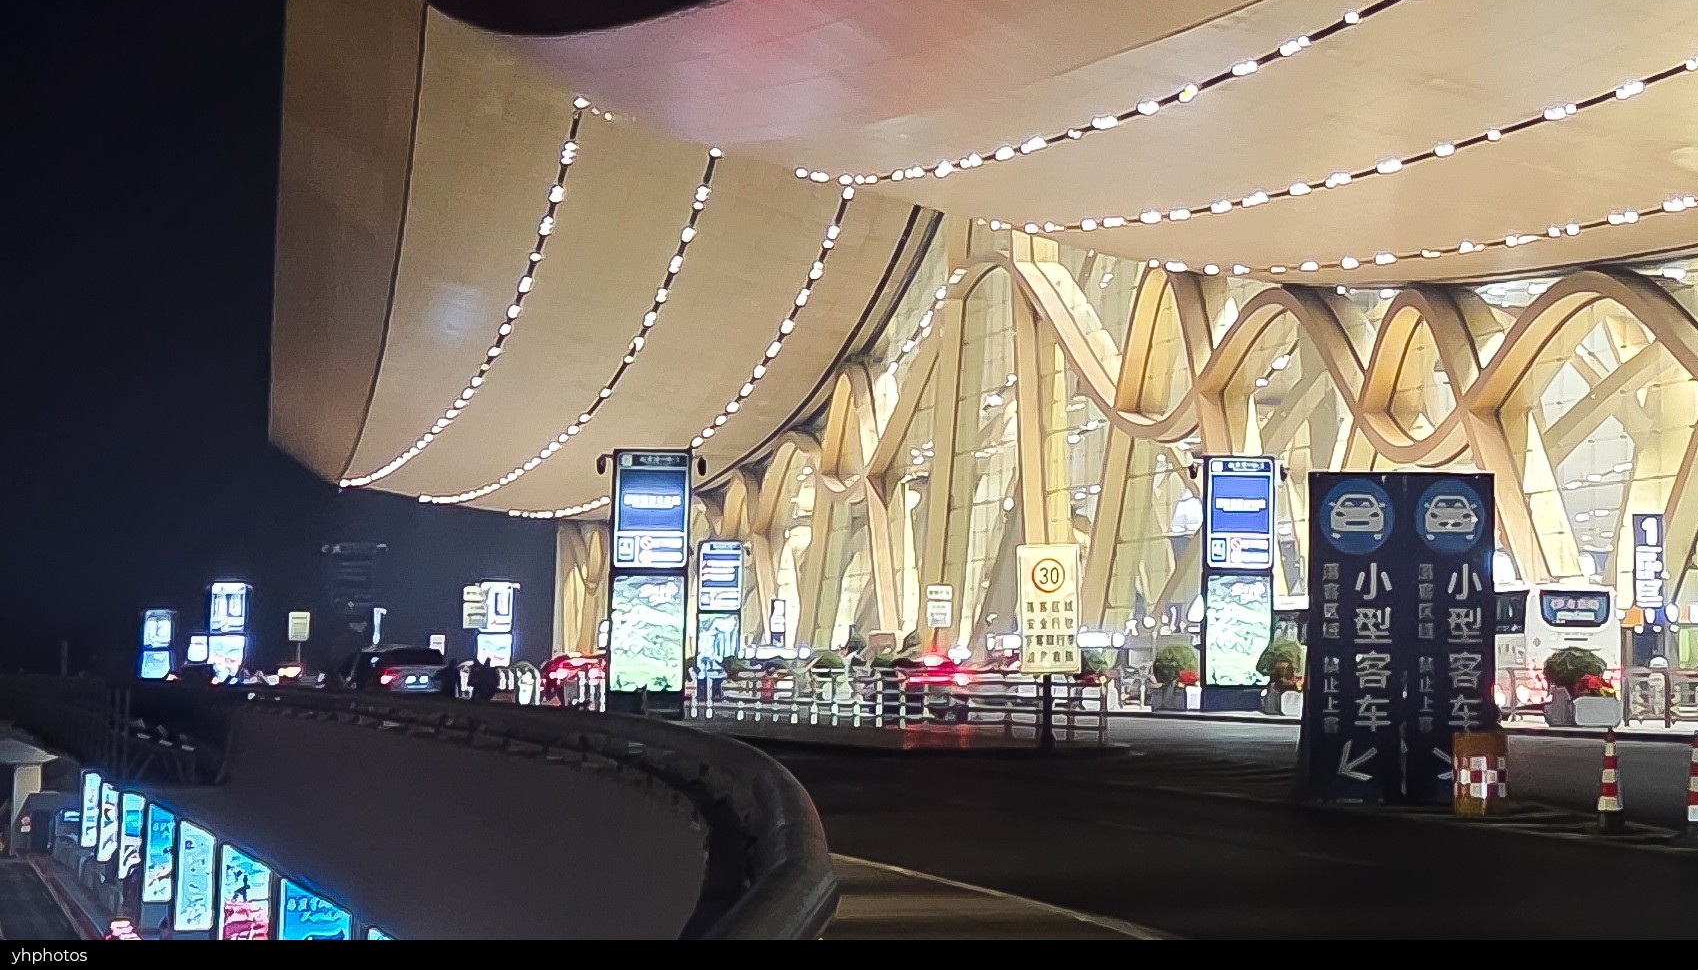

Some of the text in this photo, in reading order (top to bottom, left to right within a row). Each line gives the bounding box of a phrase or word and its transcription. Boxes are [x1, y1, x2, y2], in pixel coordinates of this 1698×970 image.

[1039, 567, 1059, 585] 30
[1354, 563, 1392, 732] 小型客车
[1448, 563, 1483, 732] 小型客车
